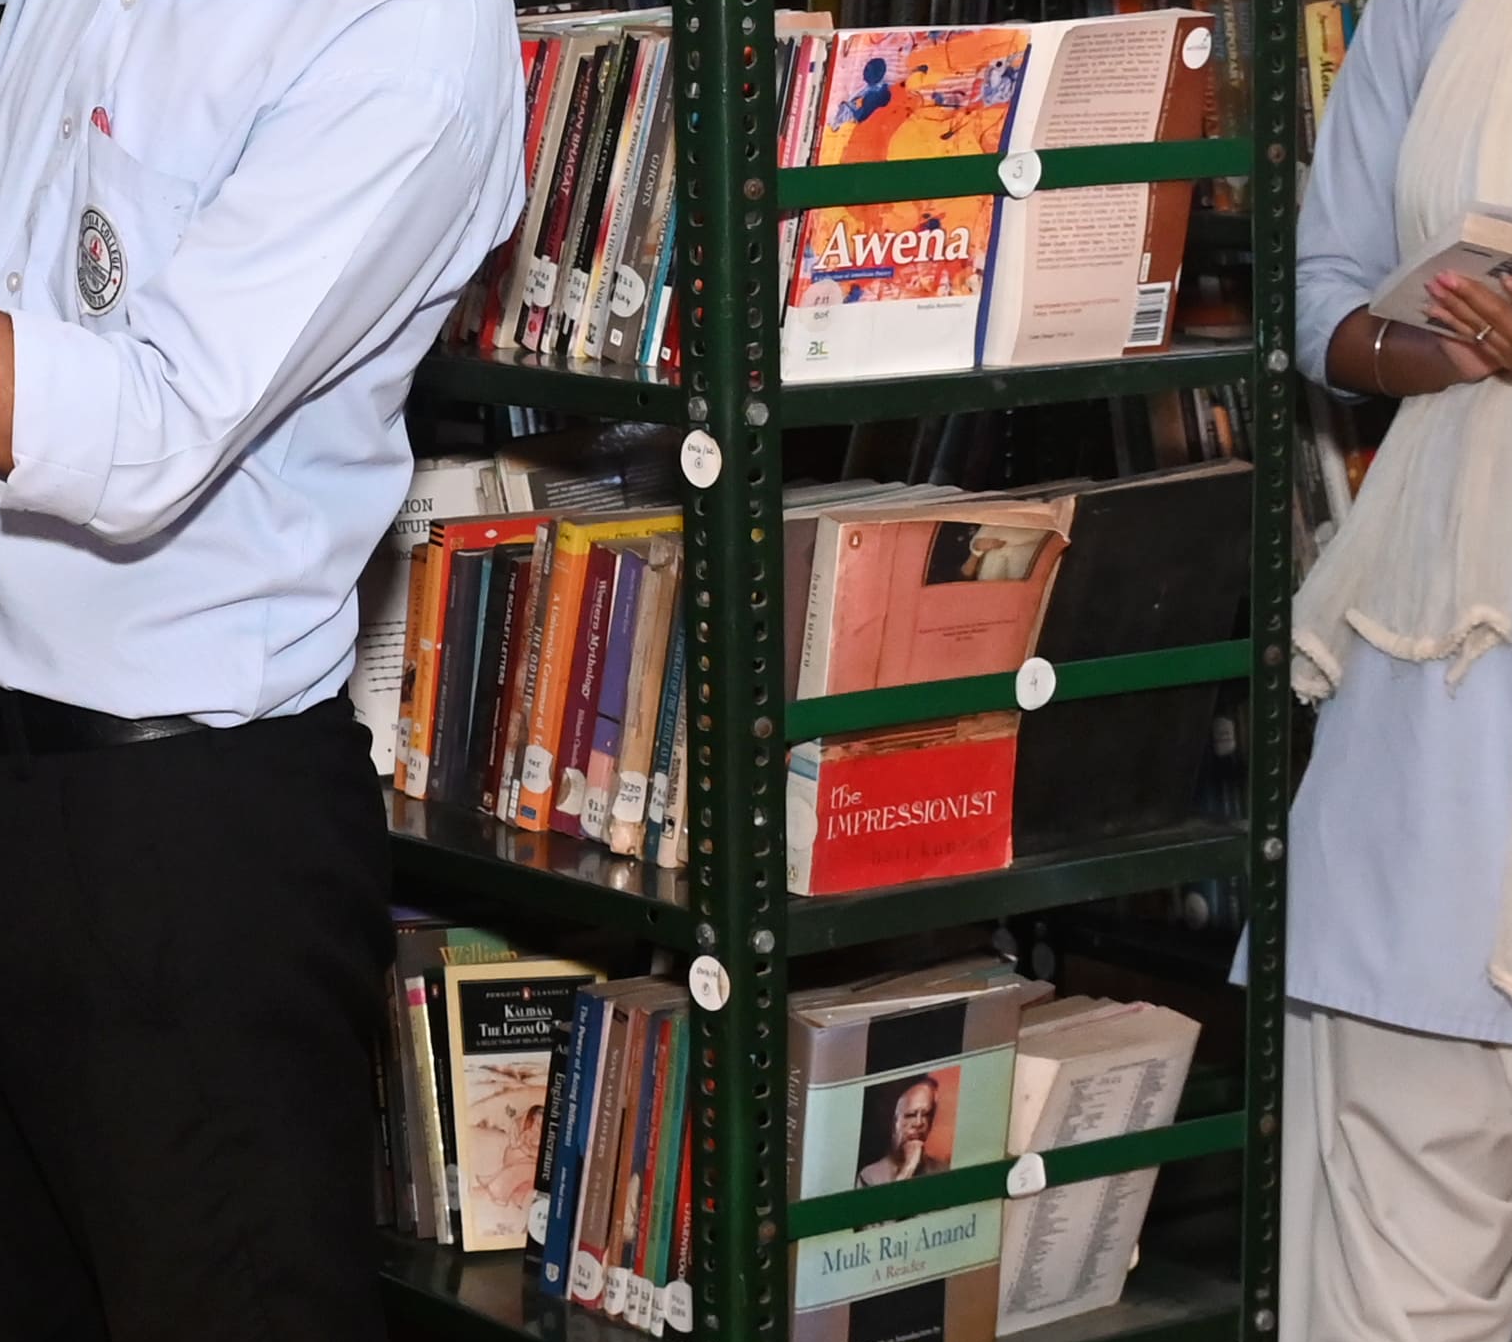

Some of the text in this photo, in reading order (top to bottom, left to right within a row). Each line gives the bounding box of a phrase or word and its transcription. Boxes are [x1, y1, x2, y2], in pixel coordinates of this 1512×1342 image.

[814, 221, 971, 272] Awena
[579, 577, 608, 703] Western Mythology
[826, 790, 998, 841] IMPRESSIONIST
[820, 1213, 978, 1277] Mulk Raj Anand
